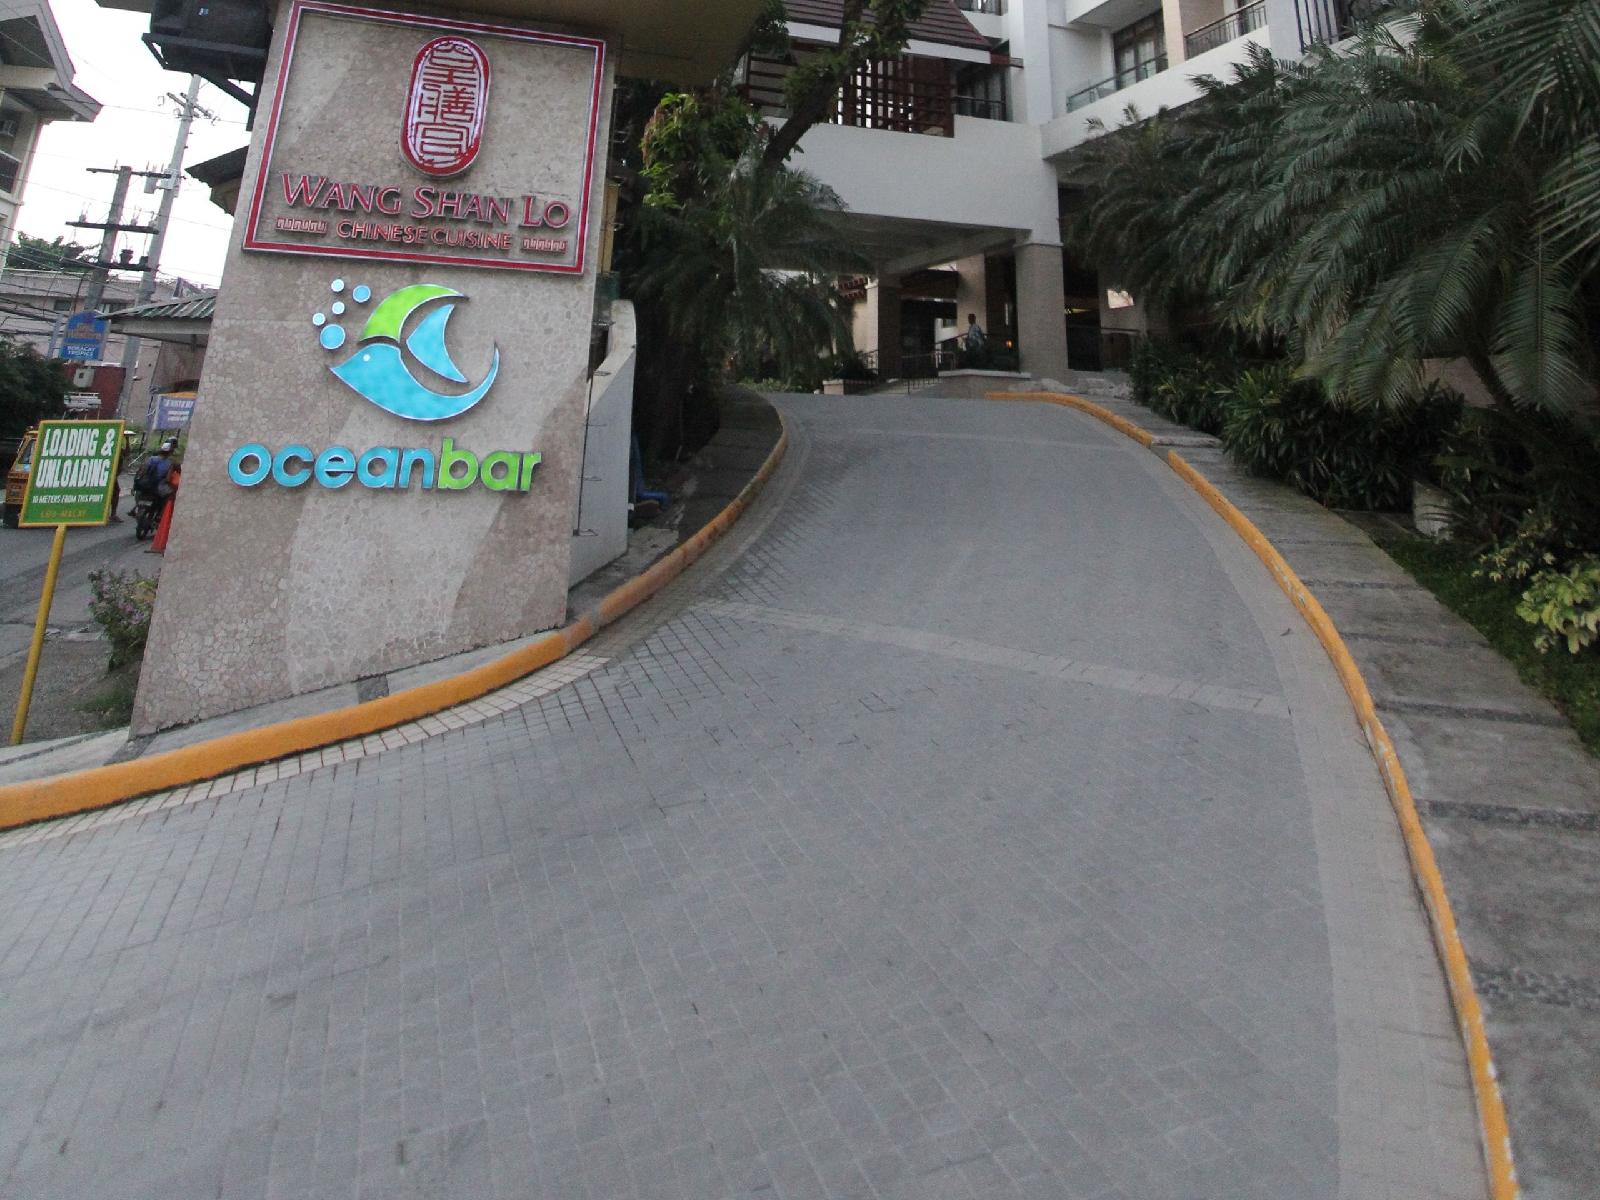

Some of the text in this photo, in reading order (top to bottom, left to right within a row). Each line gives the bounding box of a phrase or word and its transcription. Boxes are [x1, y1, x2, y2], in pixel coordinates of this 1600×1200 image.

[520, 195, 571, 230] LO
[336, 218, 512, 250] CHINESE CUISINE
[41, 428, 116, 457] LOADING &
[35, 458, 111, 488] UNLOADING
[39, 495, 61, 504] METERS
[61, 495, 77, 503] FROM
